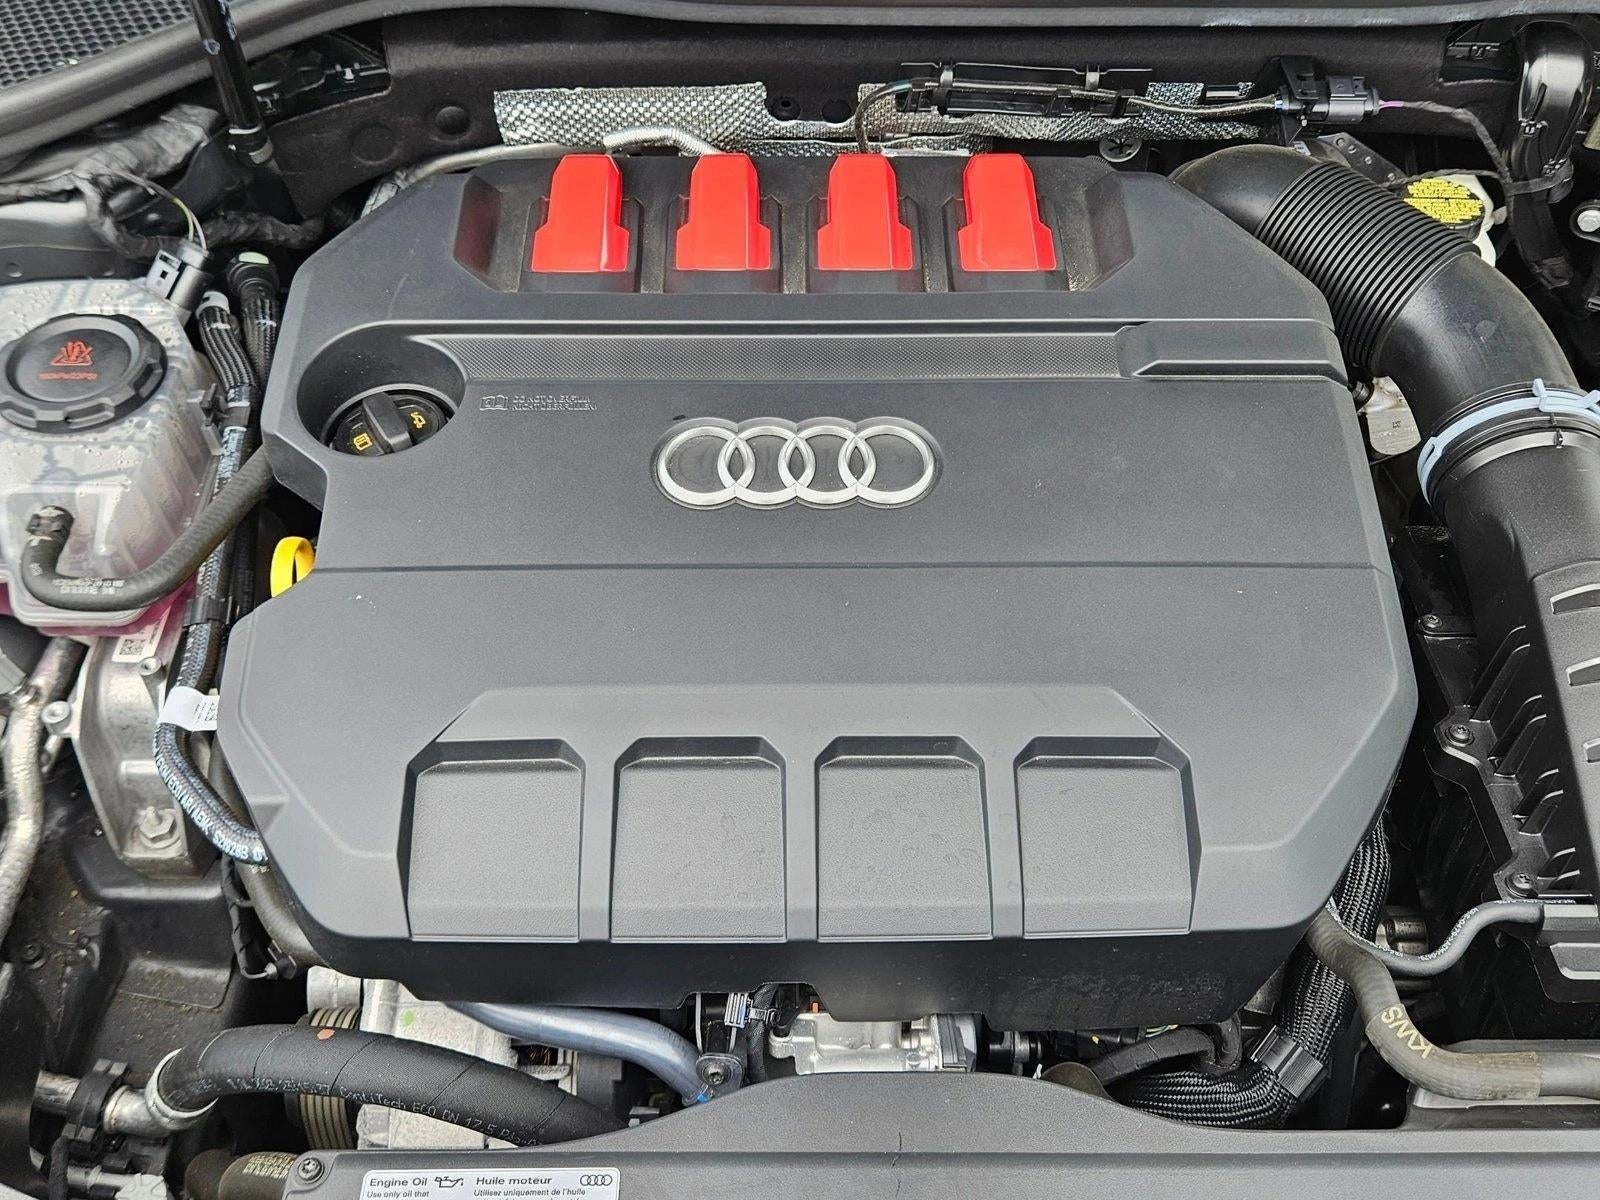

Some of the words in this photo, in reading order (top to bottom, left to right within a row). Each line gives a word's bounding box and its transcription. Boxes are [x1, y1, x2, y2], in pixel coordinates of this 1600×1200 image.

[1380, 1005, 1434, 1060] KWS
[369, 1177, 409, 1189] Engine
[412, 1176, 428, 1187] Oil
[475, 1176, 506, 1186] Huile
[508, 1177, 553, 1186] moteur
[366, 1190, 379, 1198] Use
[383, 1190, 401, 1200] only
[403, 1190, 413, 1198] oil
[414, 1190, 430, 1198] that
[473, 1188, 502, 1197] Utilisez
[503, 1188, 549, 1198] uniquement
[551, 1187, 561, 1196] de
[562, 1187, 586, 1196] l'huile
